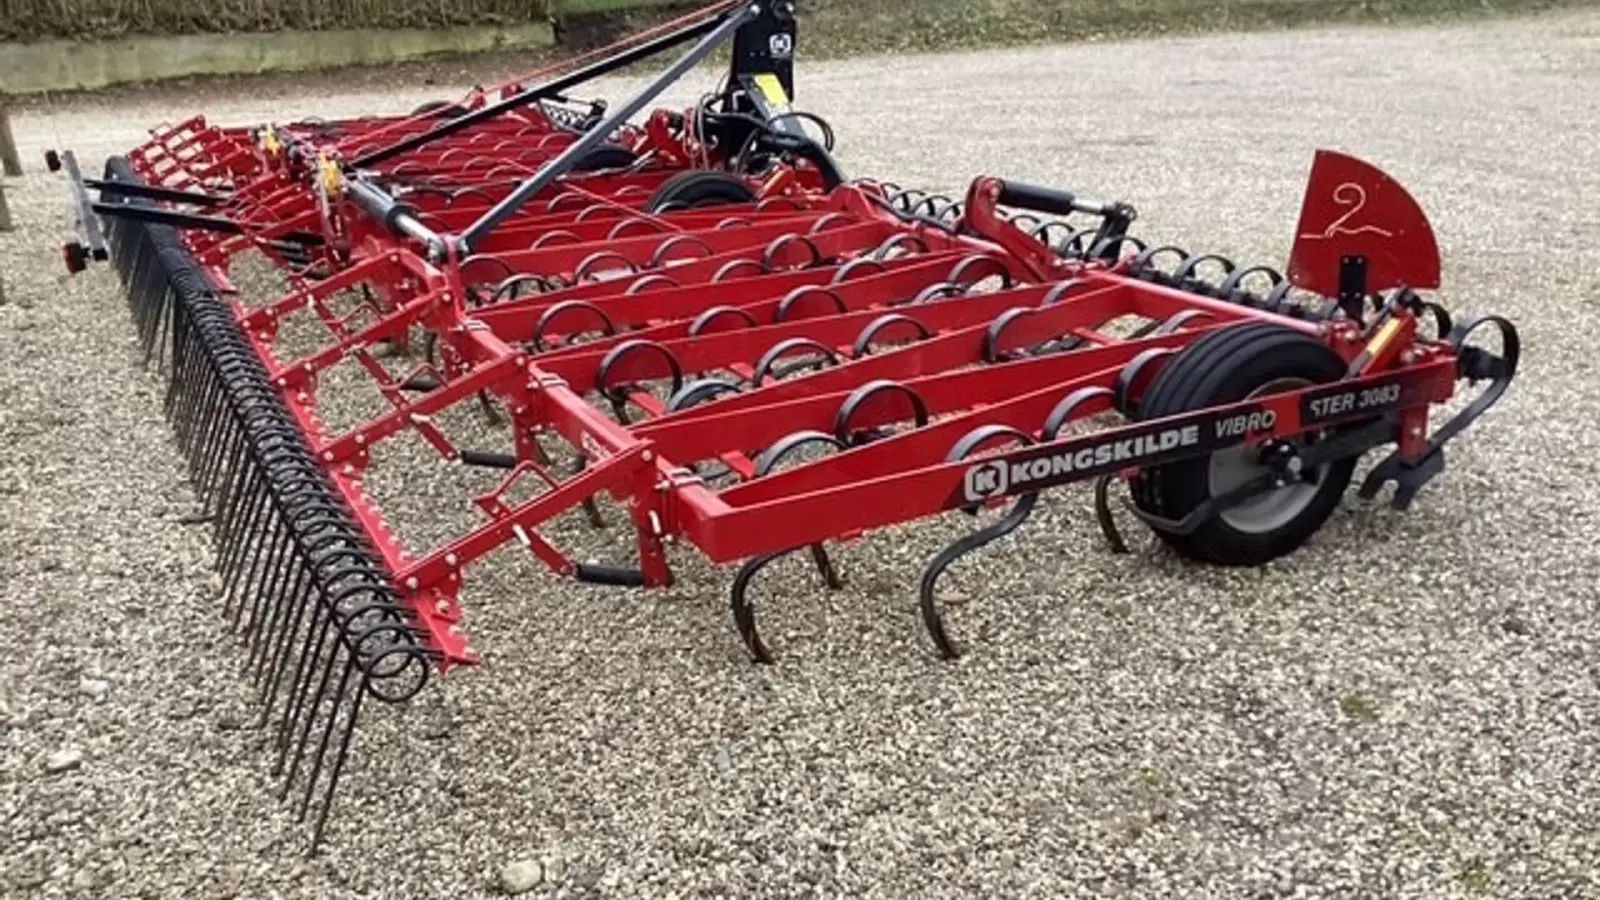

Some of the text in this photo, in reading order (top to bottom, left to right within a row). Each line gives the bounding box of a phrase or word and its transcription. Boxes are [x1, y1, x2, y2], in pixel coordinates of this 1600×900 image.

[1318, 182, 1392, 239] 2
[1010, 425, 1200, 484] KONGSKILDE
[1215, 410, 1277, 438] VIBRO
